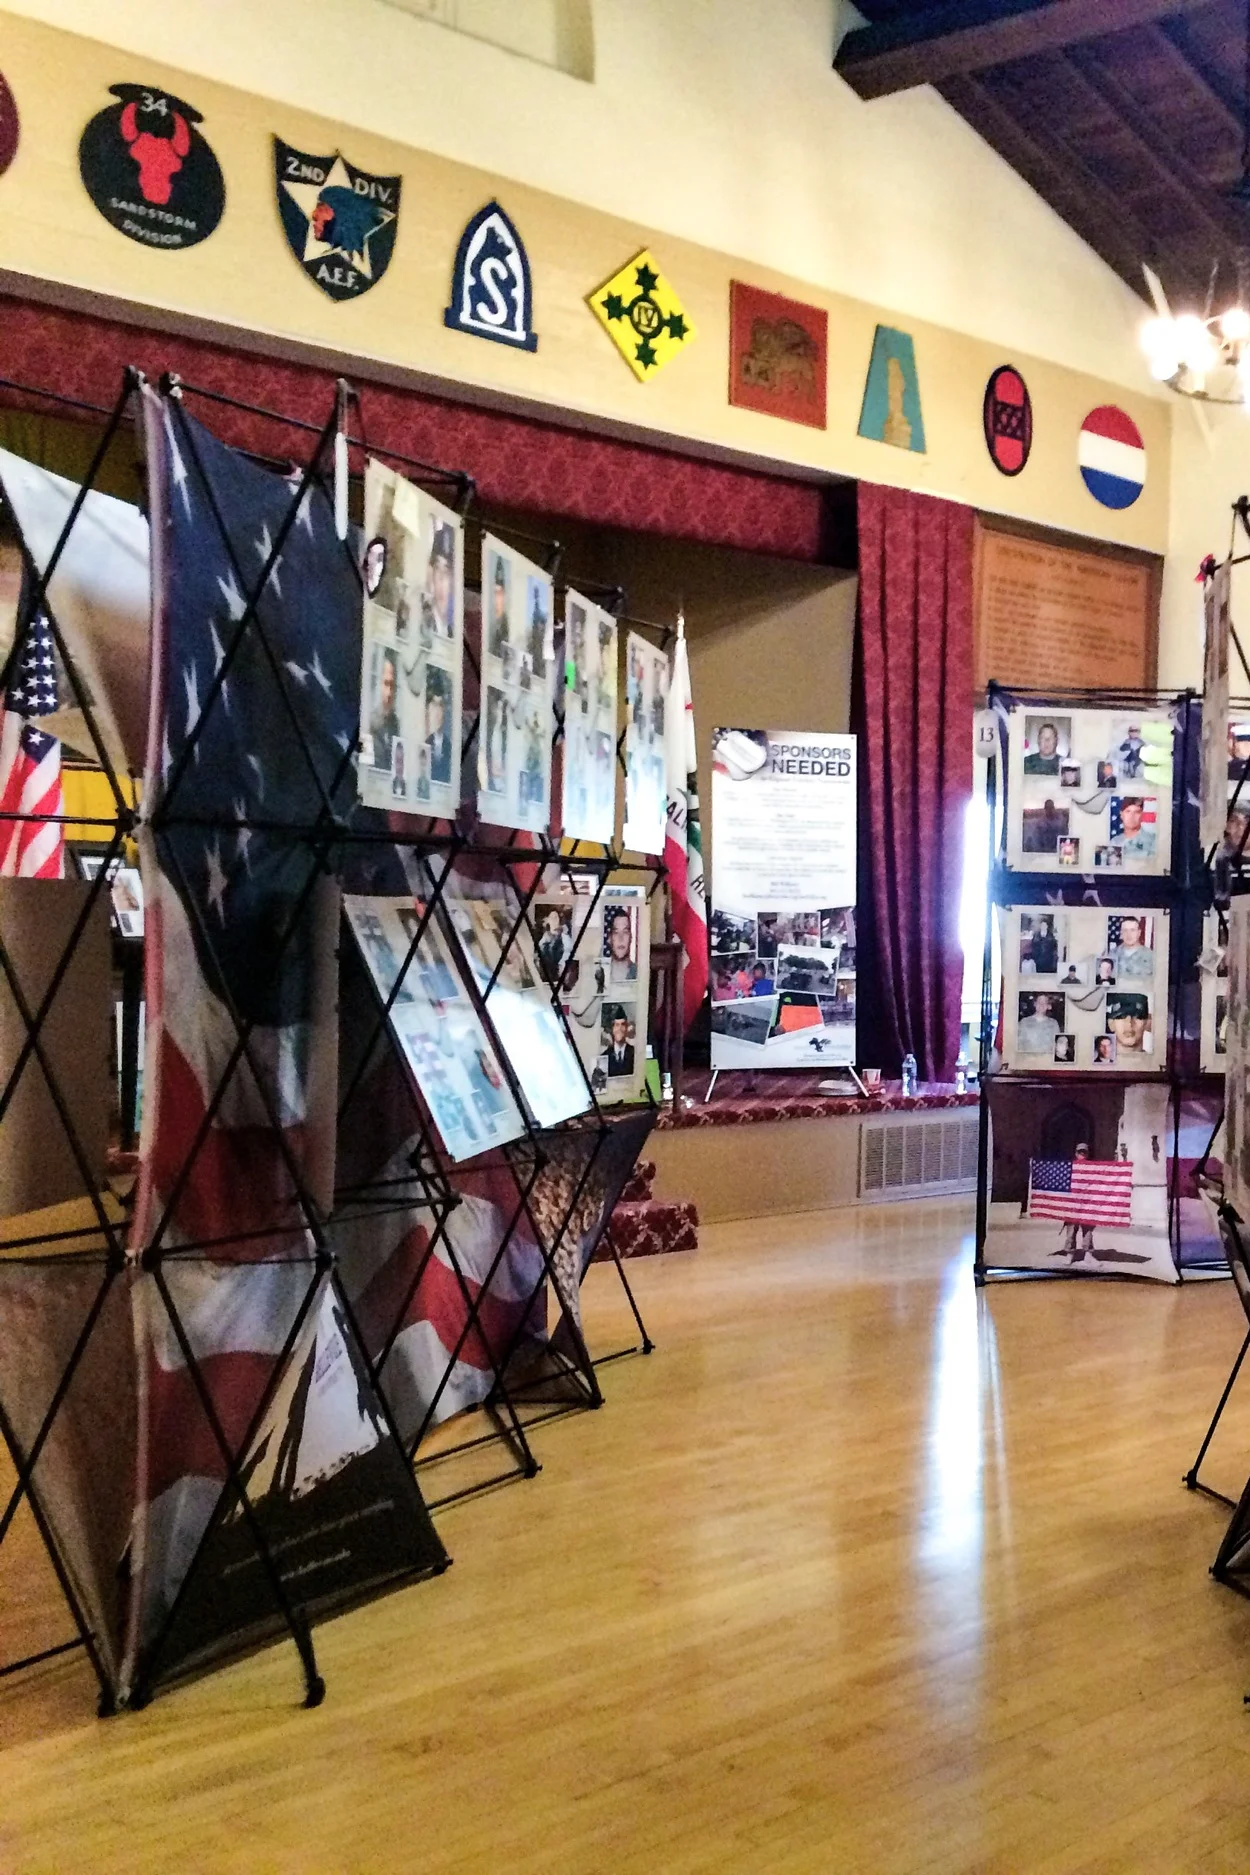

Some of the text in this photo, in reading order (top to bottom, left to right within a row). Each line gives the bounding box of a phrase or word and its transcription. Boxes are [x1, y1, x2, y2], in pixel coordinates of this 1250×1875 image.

[141, 92, 168, 116] 34
[286, 156, 393, 204] 2ND DIV.
[110, 197, 197, 231] SANDSTORM
[122, 219, 183, 244] DIVISION
[637, 305, 658, 328] IV
[980, 727, 994, 742] 13
[771, 744, 852, 760] SPONSORS
[772, 759, 851, 777] NEEDED
